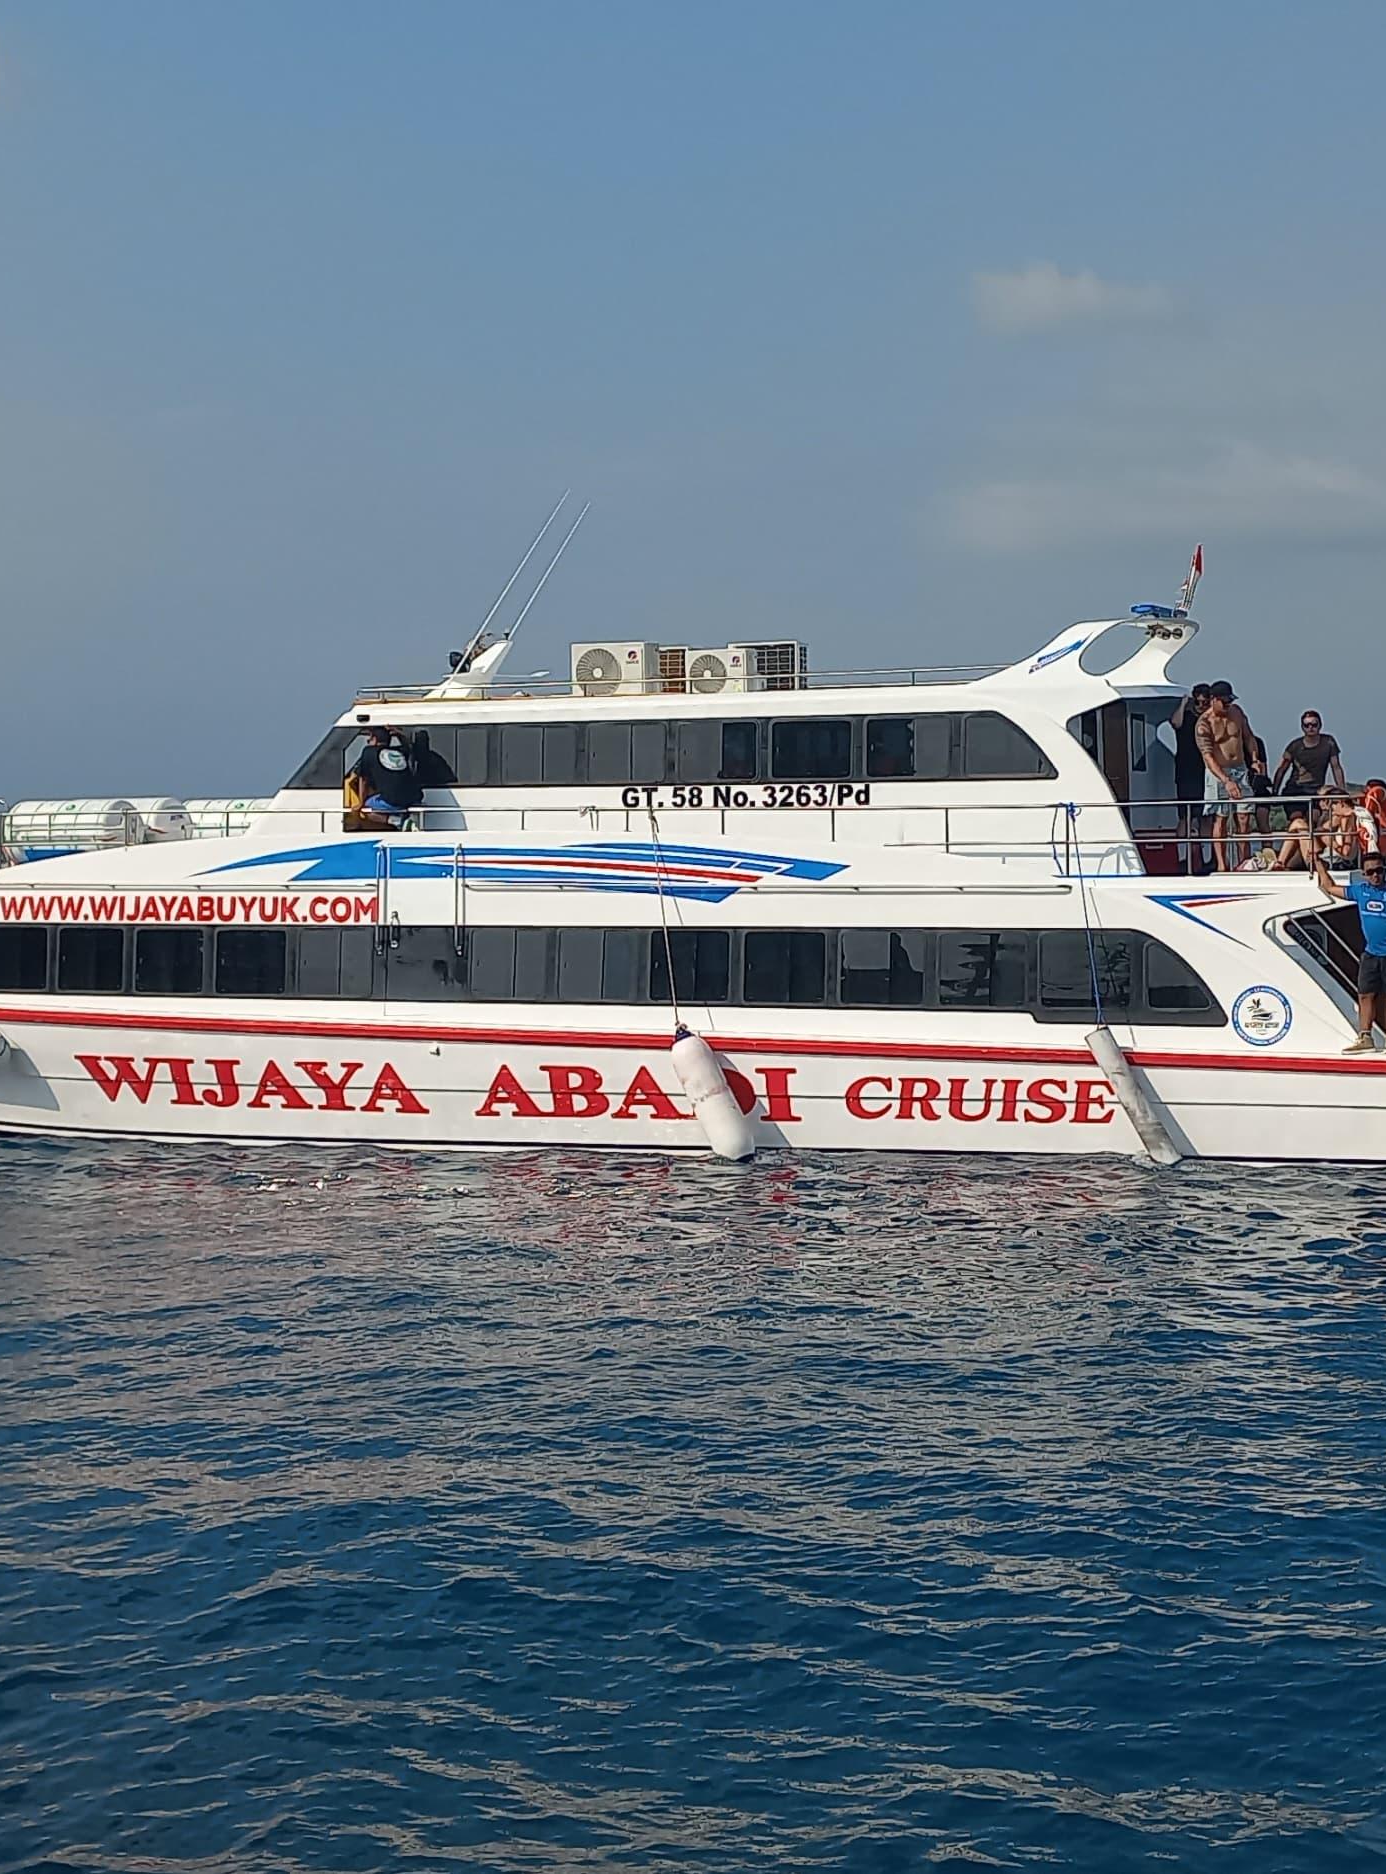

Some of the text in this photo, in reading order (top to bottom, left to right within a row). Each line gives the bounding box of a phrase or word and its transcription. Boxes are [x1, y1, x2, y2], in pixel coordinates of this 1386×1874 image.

[621, 783, 871, 808] GT. 58 No. 3263/Pd
[73, 1054, 430, 1116] WIJAYA
[844, 1075, 1116, 1124] CRUISE
